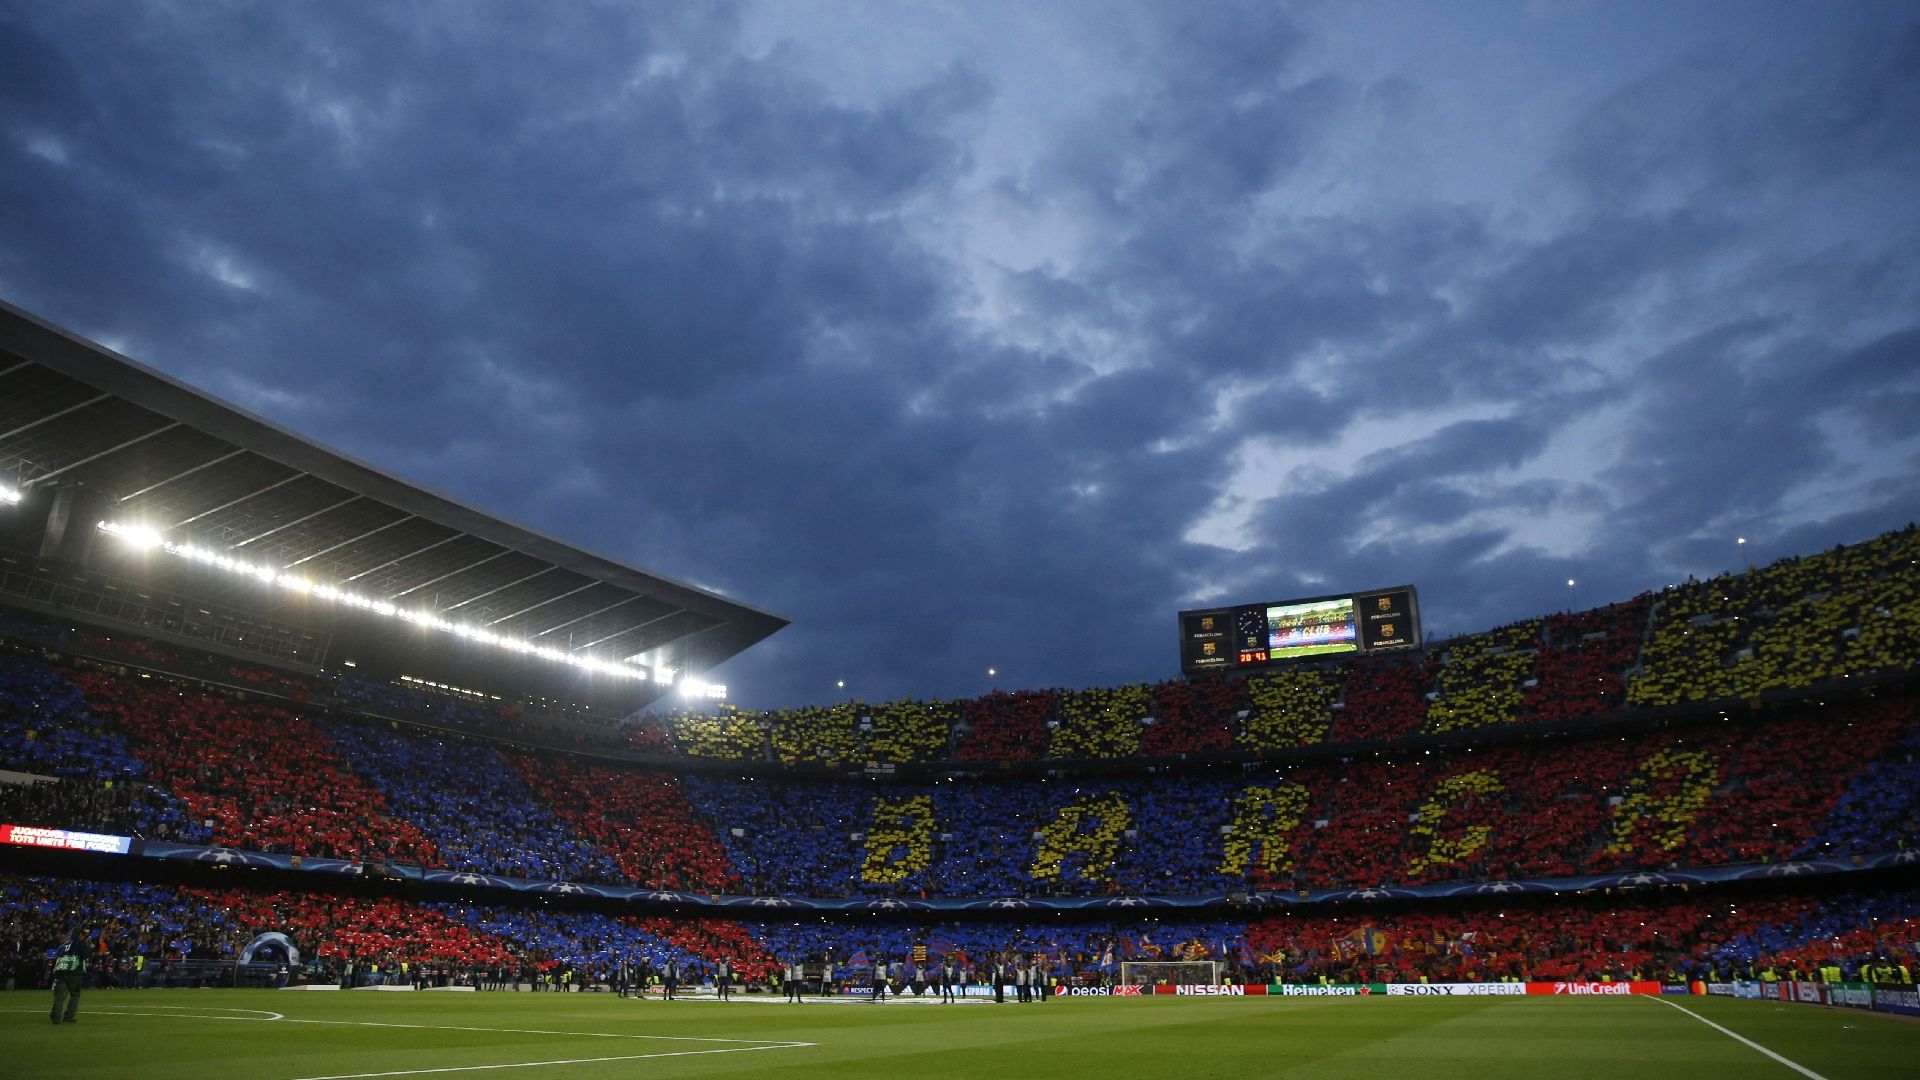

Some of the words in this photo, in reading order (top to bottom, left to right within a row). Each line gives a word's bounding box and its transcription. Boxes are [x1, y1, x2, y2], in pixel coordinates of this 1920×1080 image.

[1071, 983, 1110, 996] pepsi
[1113, 984, 1144, 996] MAX
[1176, 984, 1245, 996] NISSAN
[1282, 984, 1355, 996] Heineken
[1404, 985, 1454, 995] SONY
[1466, 985, 1521, 995] XPERIA
[1568, 982, 1631, 995] UniCredit
